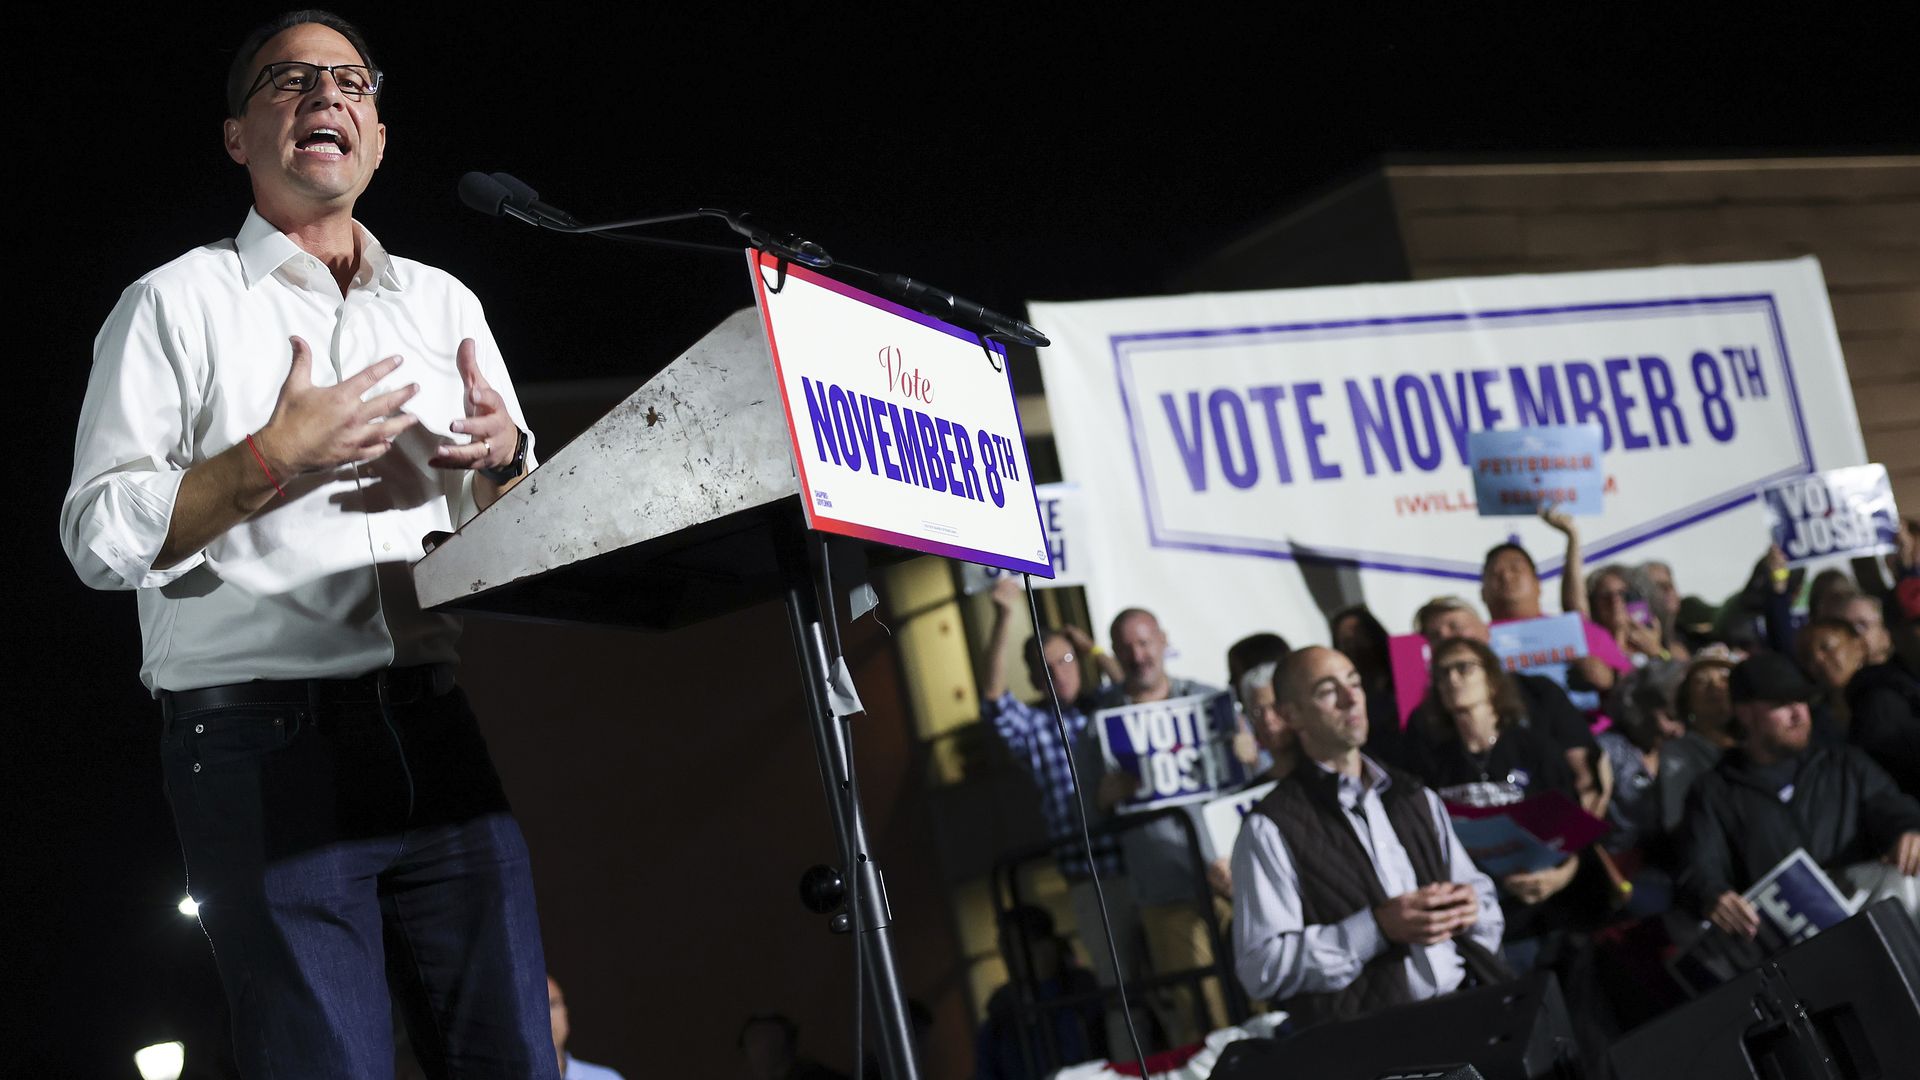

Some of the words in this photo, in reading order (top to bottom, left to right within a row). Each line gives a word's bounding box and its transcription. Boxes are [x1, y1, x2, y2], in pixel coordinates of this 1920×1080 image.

[879, 345, 935, 404] Vote
[801, 375, 985, 503] NOVEMBER
[977, 429, 1020, 509] 8TH
[1159, 381, 1343, 493] VOTE
[1343, 356, 1690, 476] NOVEMBER
[1690, 346, 1769, 444] 8TH
[1787, 506, 1878, 558] JOSH
[1121, 699, 1222, 755] VOTE
[1134, 740, 1234, 799] JOSH
